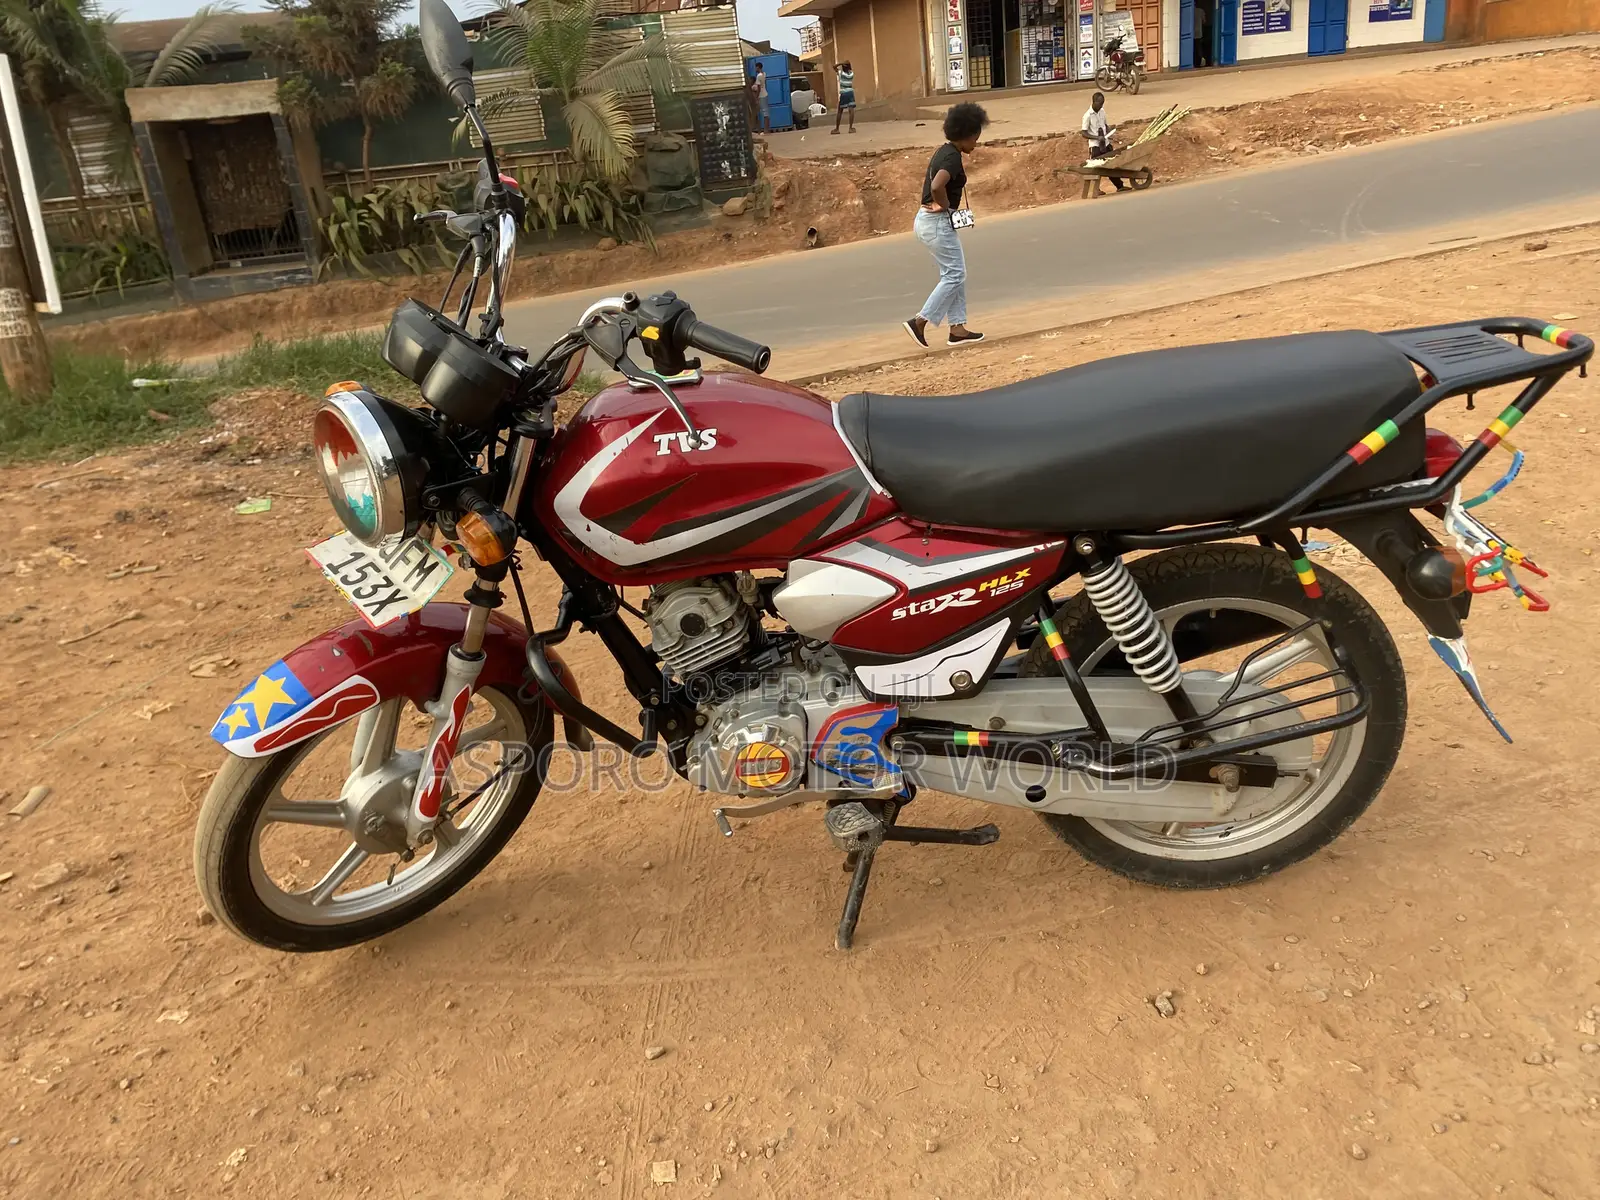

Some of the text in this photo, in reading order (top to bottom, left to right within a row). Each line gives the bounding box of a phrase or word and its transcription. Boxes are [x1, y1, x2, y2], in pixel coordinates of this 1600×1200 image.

[326, 551, 408, 617] 153X
[979, 567, 1032, 592] HLX
[990, 579, 1025, 597] 125
